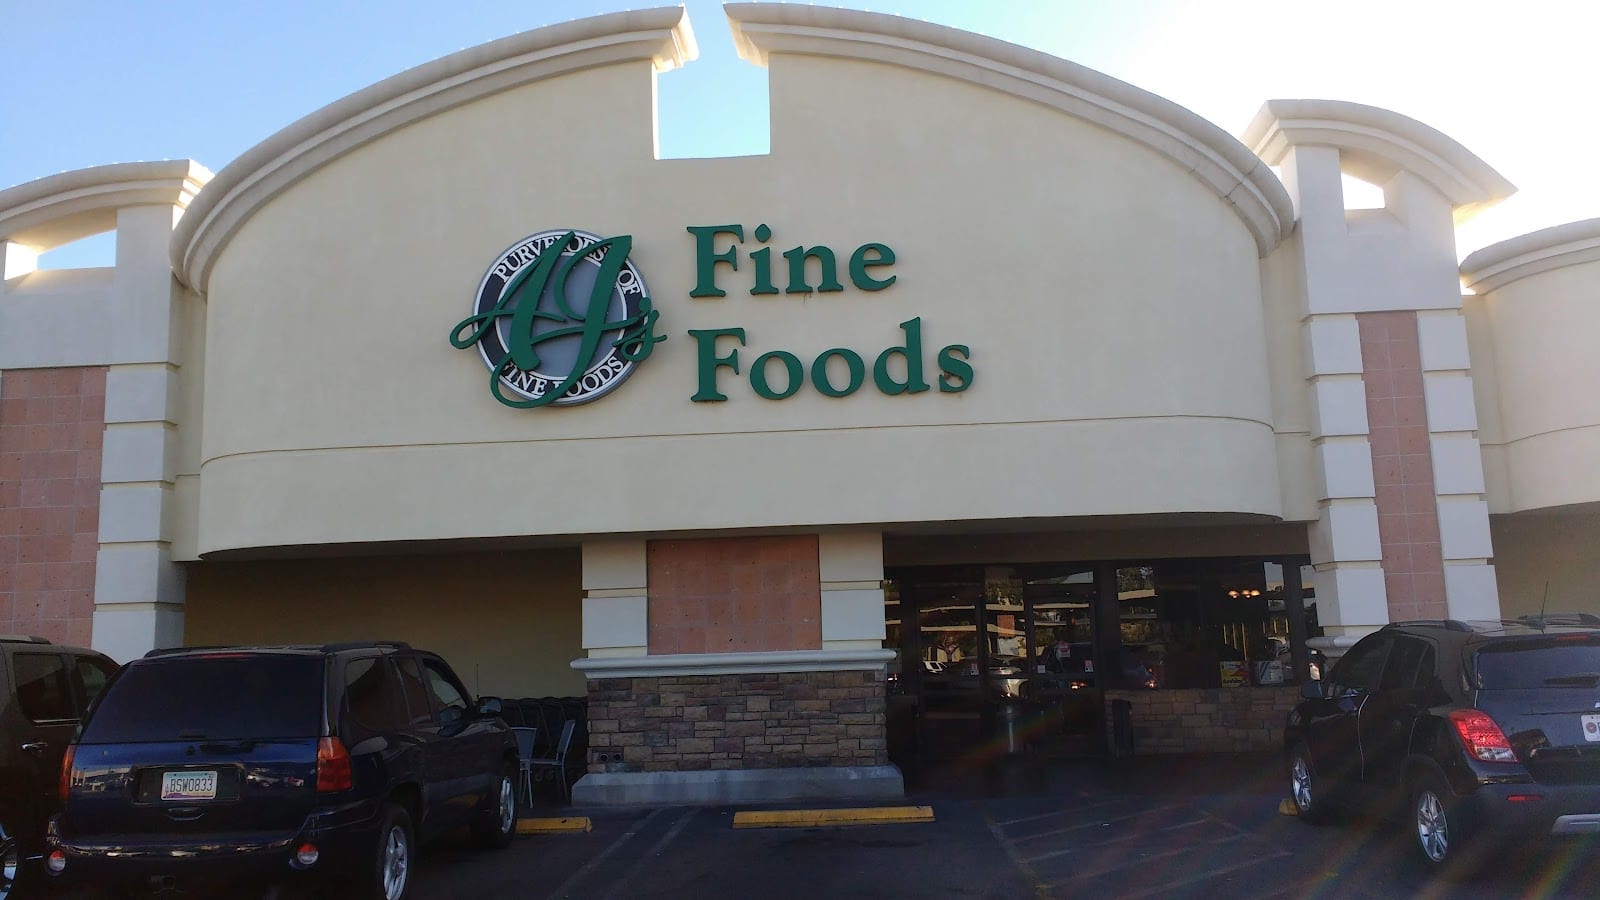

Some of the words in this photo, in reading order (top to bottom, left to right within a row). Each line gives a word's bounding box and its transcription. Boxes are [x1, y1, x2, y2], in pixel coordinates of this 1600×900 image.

[493, 235, 612, 283] PURVEOS
[617, 269, 640, 295] OF
[686, 223, 897, 298] Fine
[503, 362, 548, 396] INE
[554, 356, 624, 397] OODS
[687, 316, 974, 403] Foods
